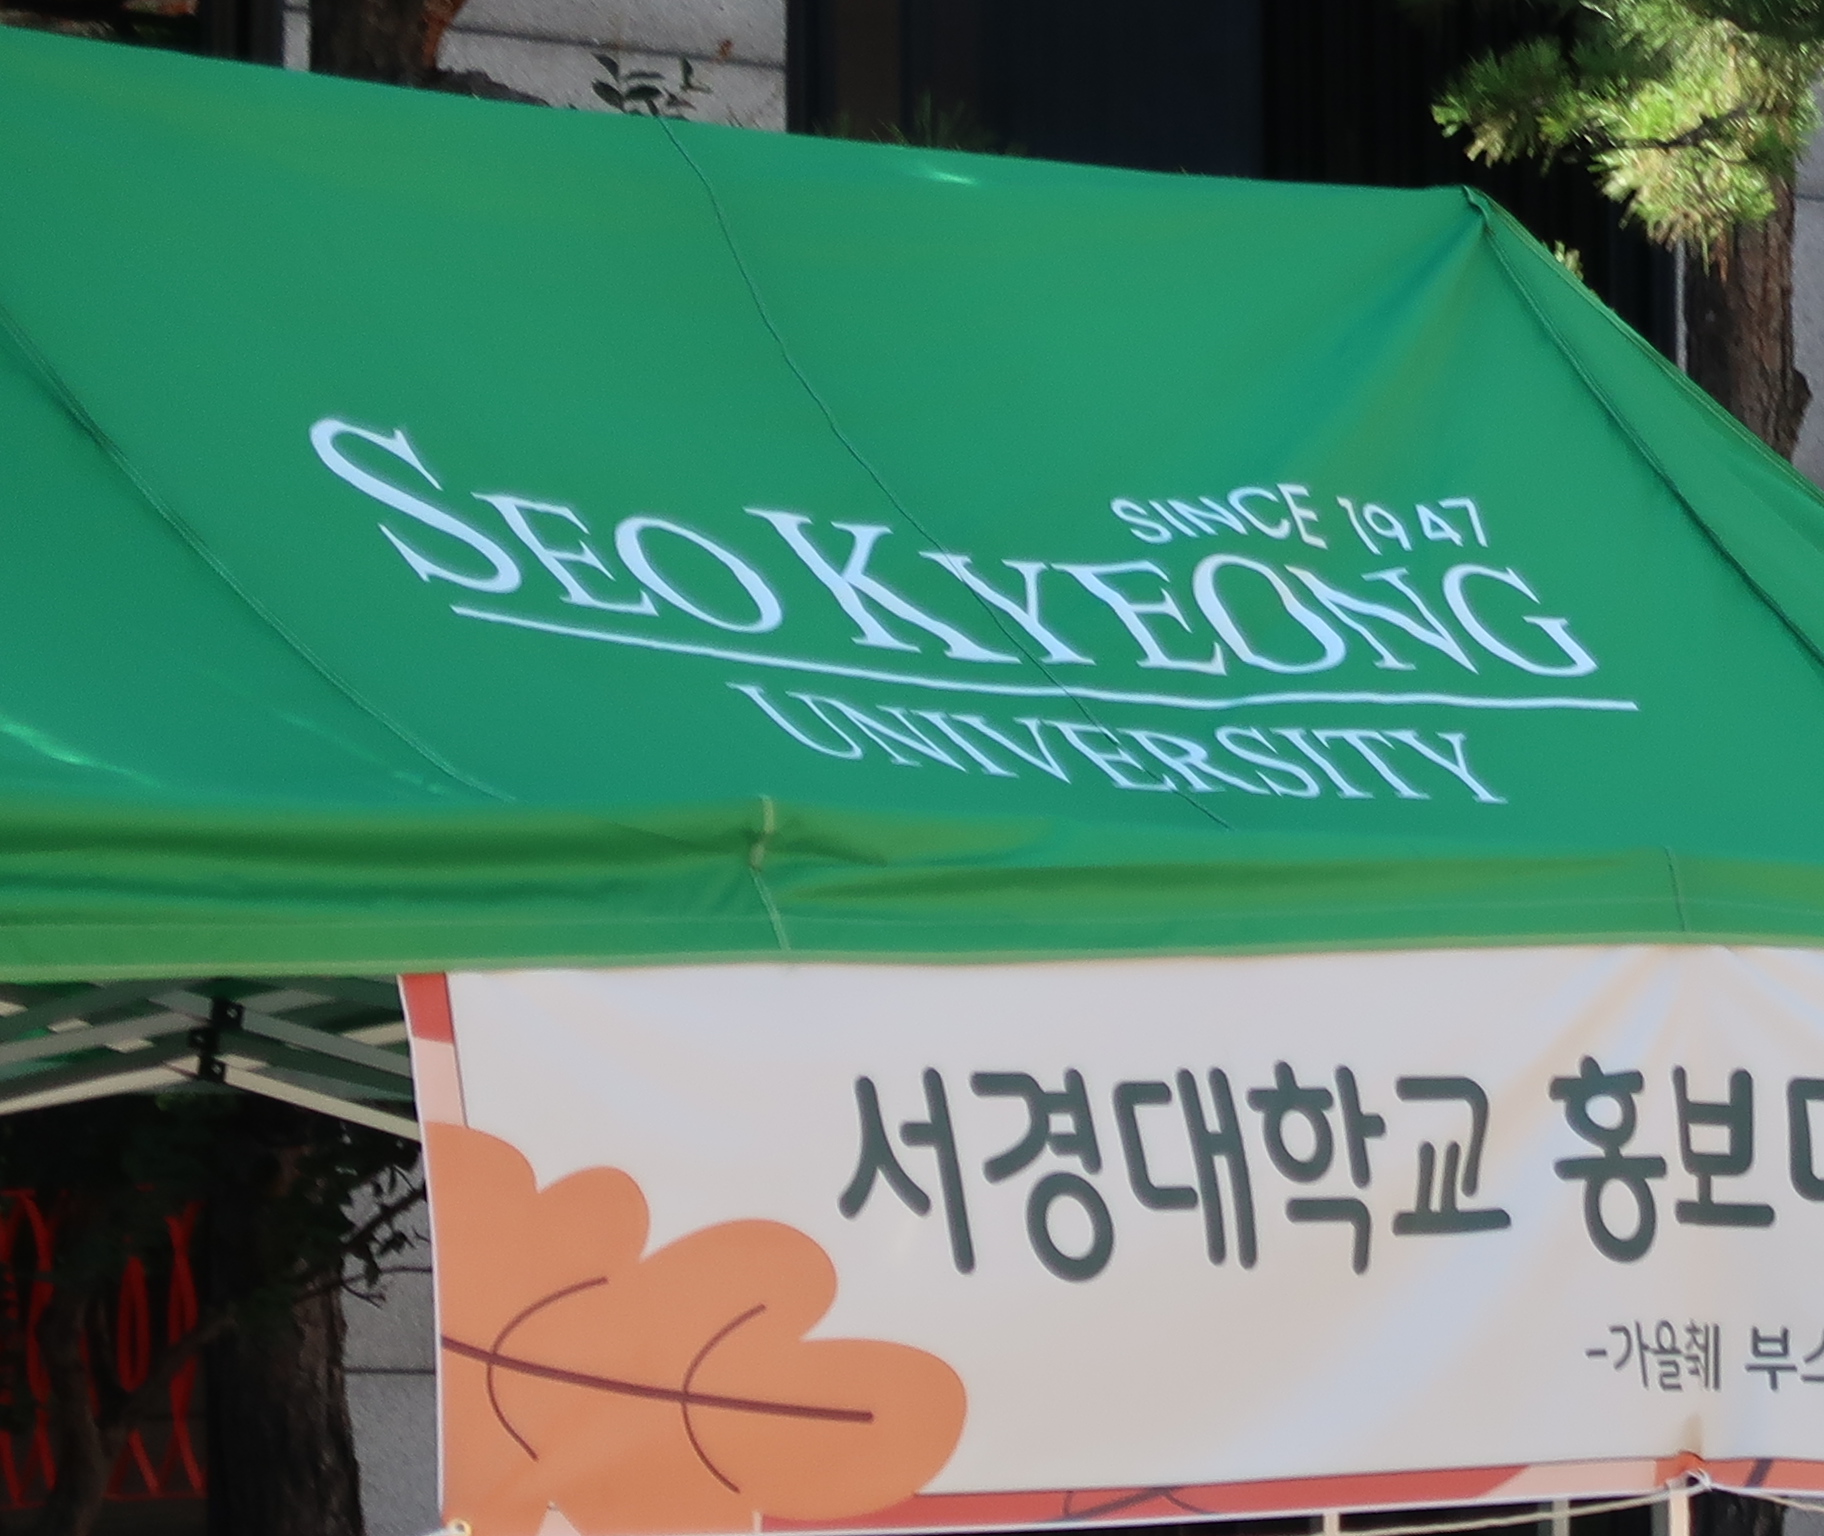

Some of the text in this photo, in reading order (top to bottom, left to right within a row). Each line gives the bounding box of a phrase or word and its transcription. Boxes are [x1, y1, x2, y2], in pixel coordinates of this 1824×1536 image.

[309, 417, 1599, 676] SEOKYEONG
[1110, 483, 1489, 556] SINCE 1947
[725, 682, 1506, 803] UNIVERSITY
[838, 1059, 1511, 1283] 서경대학교
